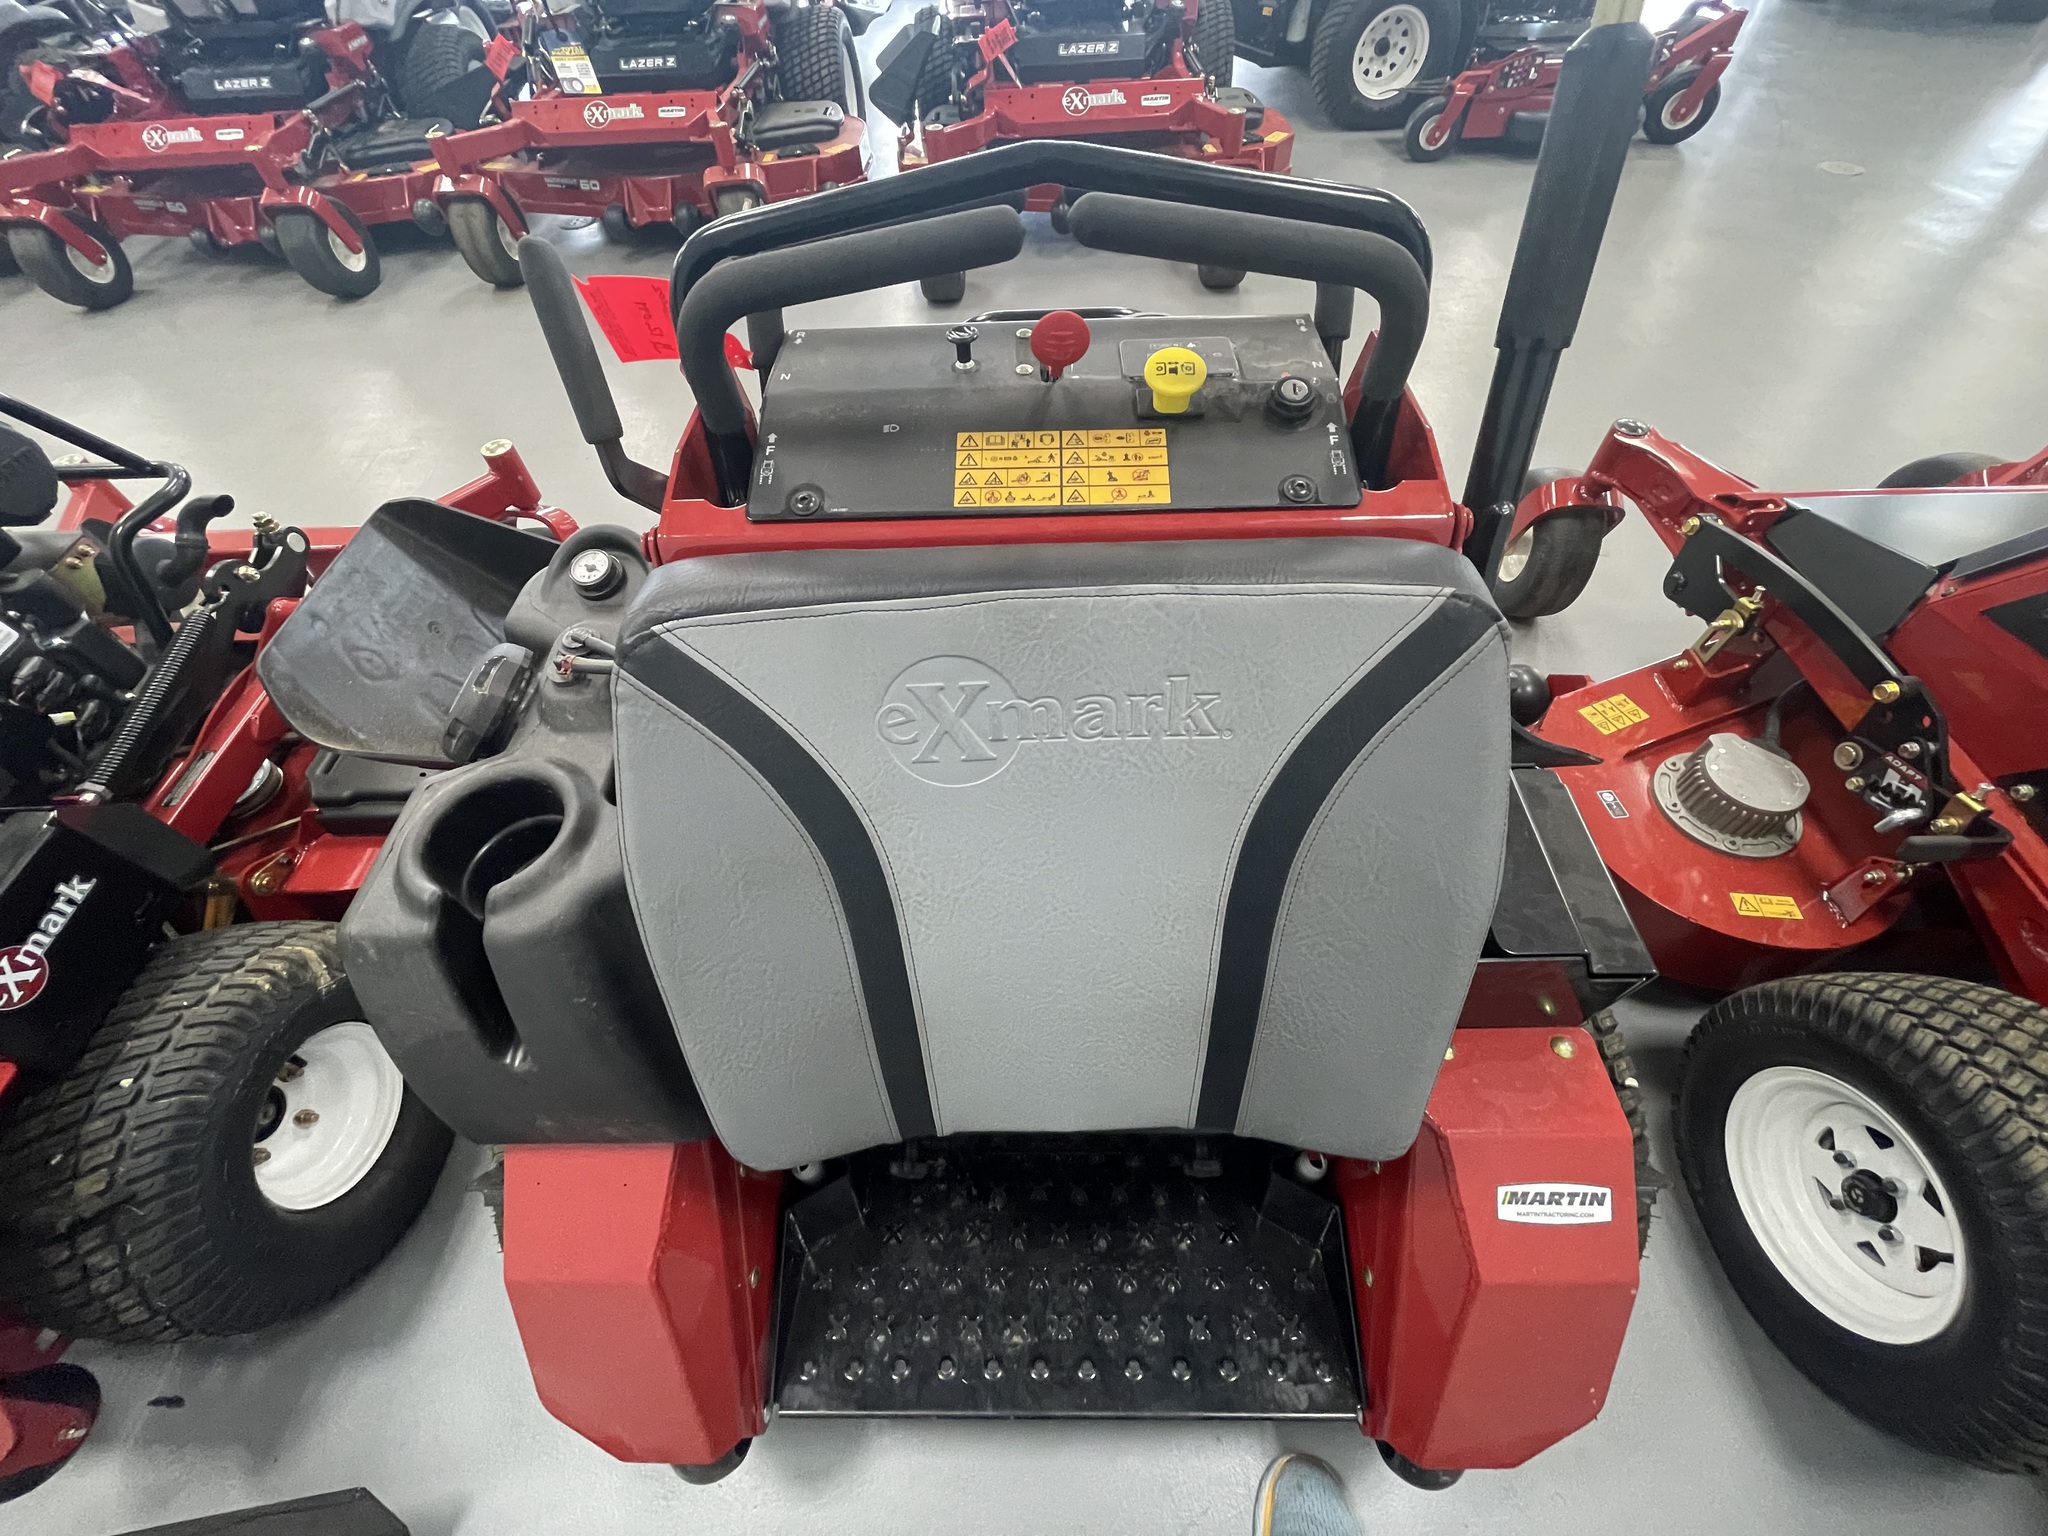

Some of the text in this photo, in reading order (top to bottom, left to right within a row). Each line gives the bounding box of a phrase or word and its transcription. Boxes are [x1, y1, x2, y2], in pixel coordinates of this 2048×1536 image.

[1059, 41, 1119, 55] LAZER Z
[620, 56, 676, 69] LAZER Z
[214, 76, 272, 91] LAZER Z
[580, 179, 600, 190] 60
[1329, 435, 1339, 446] F
[765, 445, 776, 456] F
[0, 874, 97, 1006] Xmark
[1506, 1190, 1608, 1206] MARTIN
